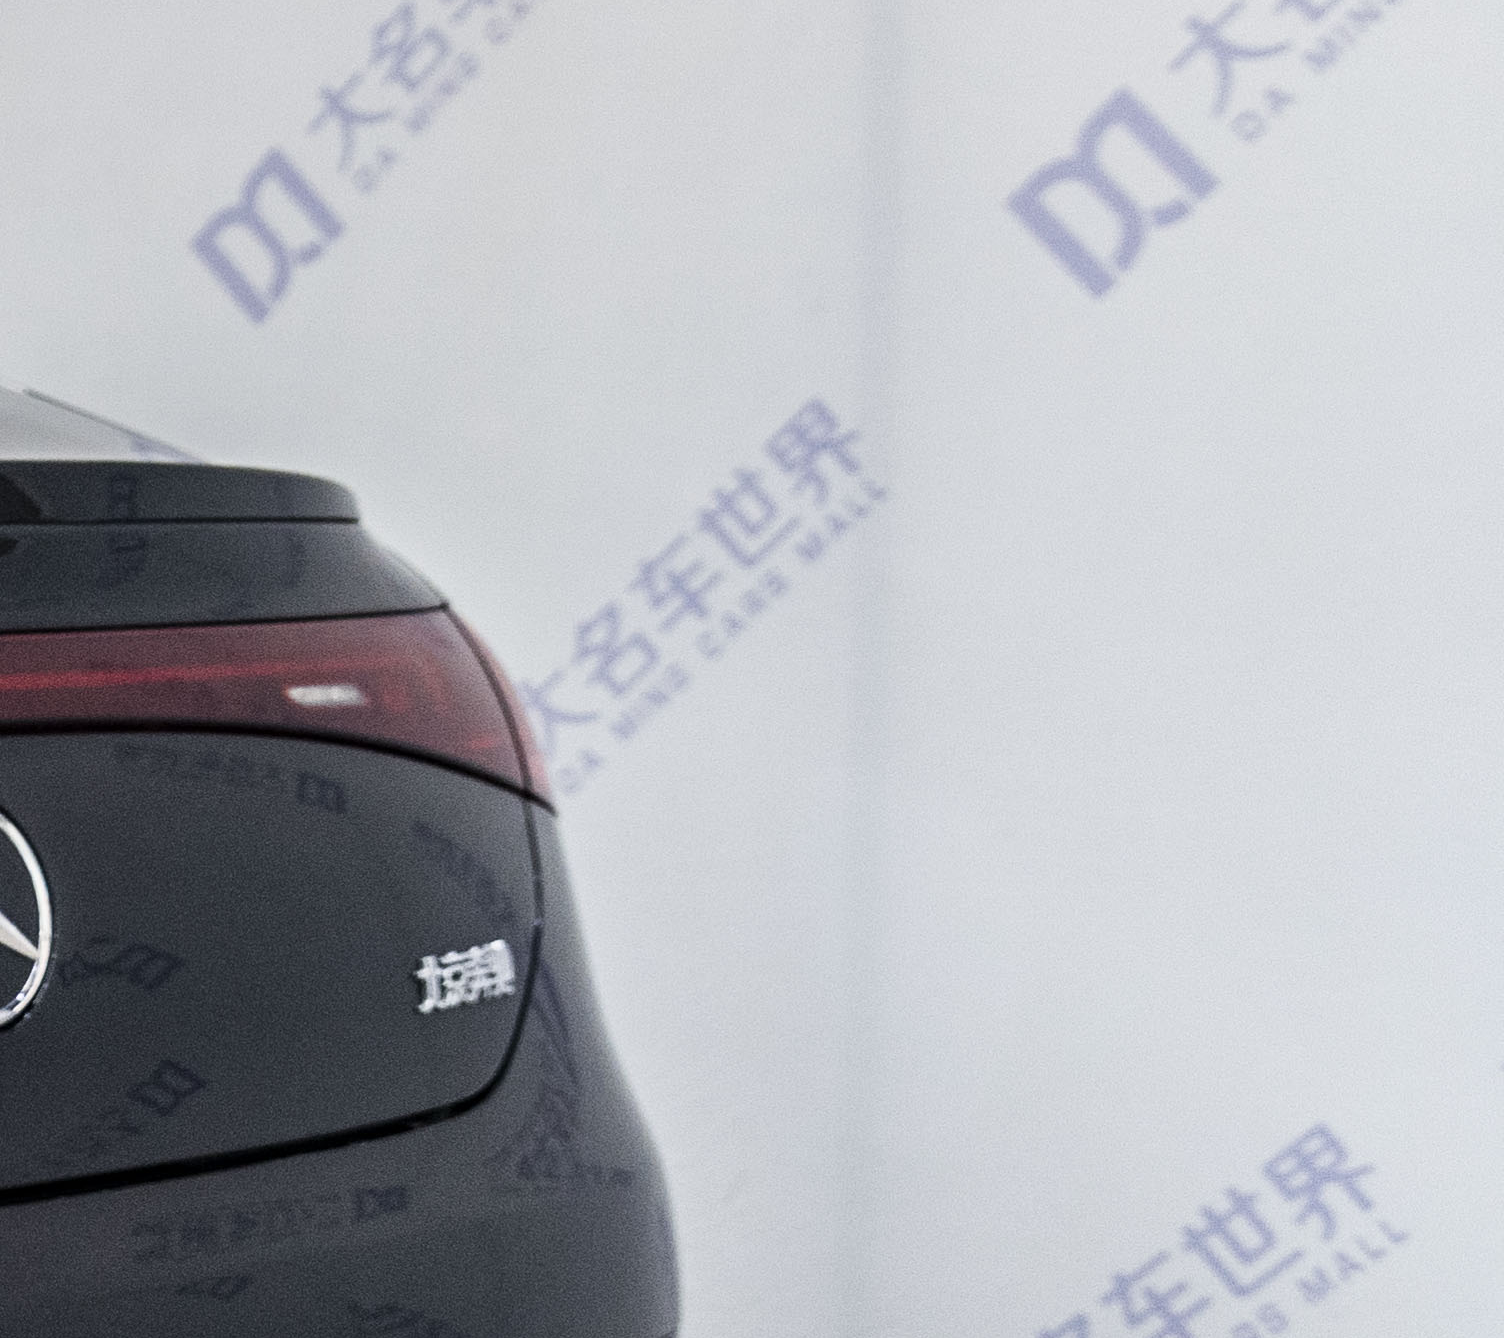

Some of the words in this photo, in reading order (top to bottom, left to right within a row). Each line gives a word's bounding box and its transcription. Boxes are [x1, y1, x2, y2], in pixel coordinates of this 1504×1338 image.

[1231, 85, 1292, 145] DA
[521, 398, 862, 748] 大名车世界
[694, 566, 791, 662] CARS
[792, 478, 888, 567] MALL
[1292, 1219, 1410, 1307] MALL
